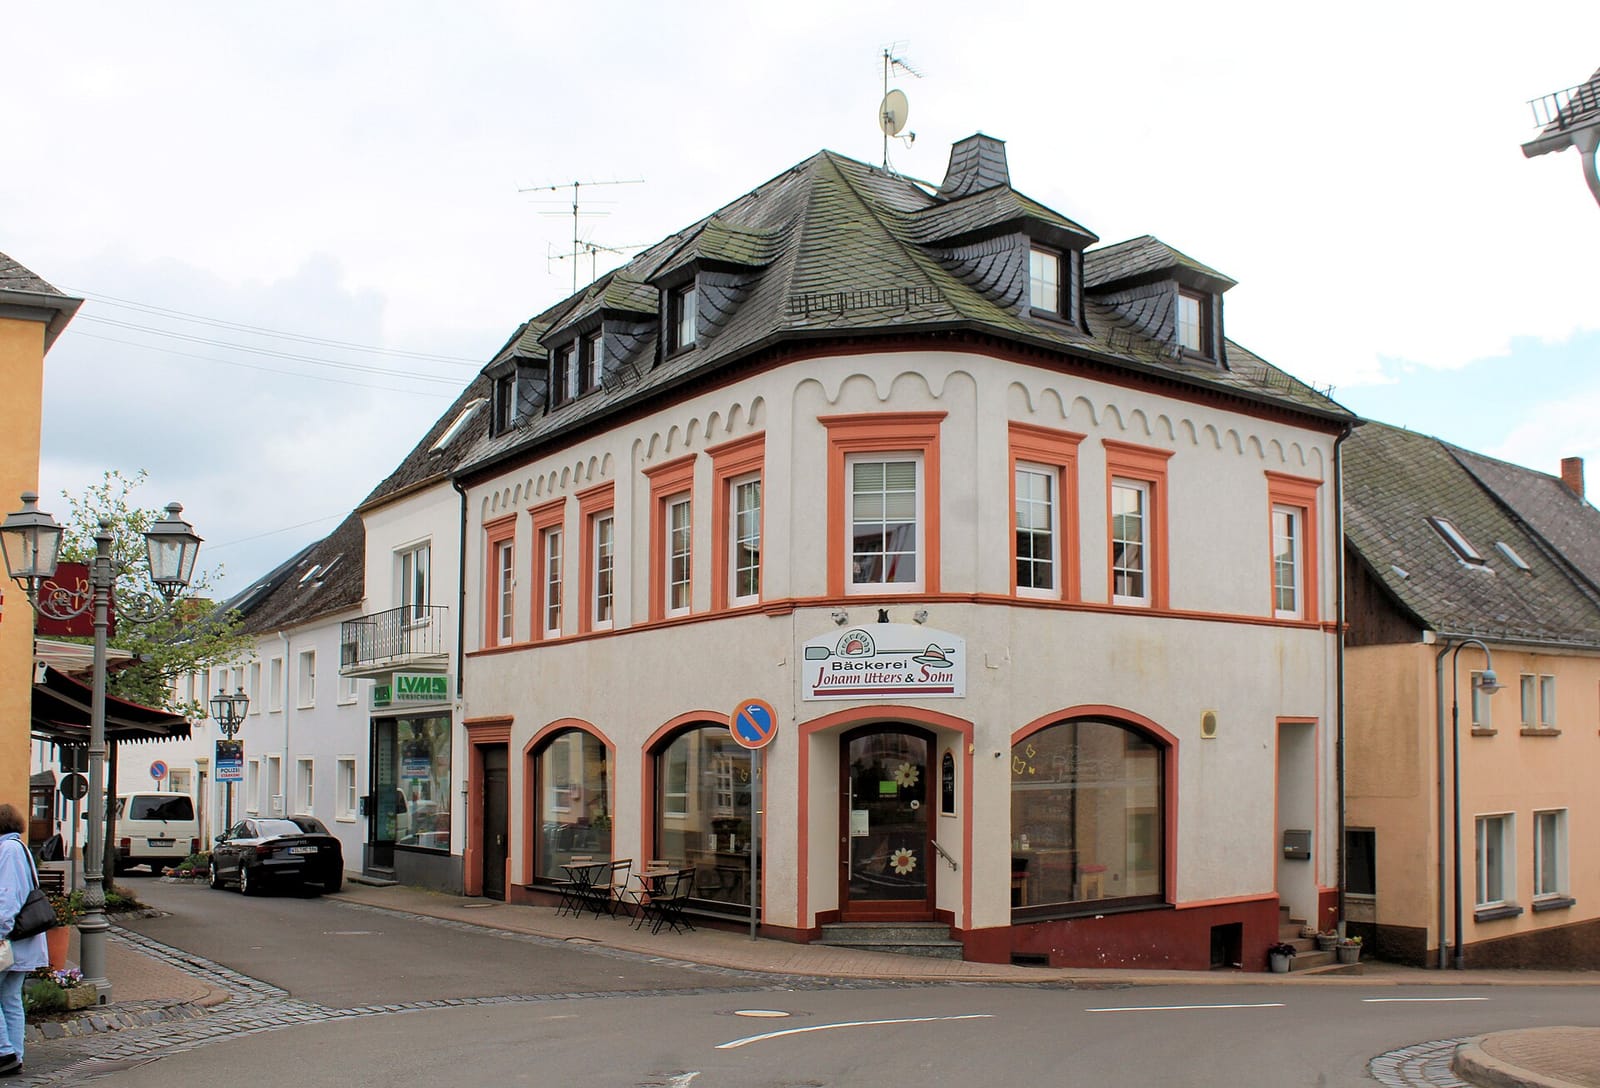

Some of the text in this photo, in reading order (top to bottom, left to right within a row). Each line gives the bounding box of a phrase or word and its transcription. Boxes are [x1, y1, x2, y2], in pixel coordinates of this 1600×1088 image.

[832, 660, 908, 671] Bäckerei
[812, 664, 953, 688] Johann Utters & Sohn
[398, 677, 431, 692] LVM
